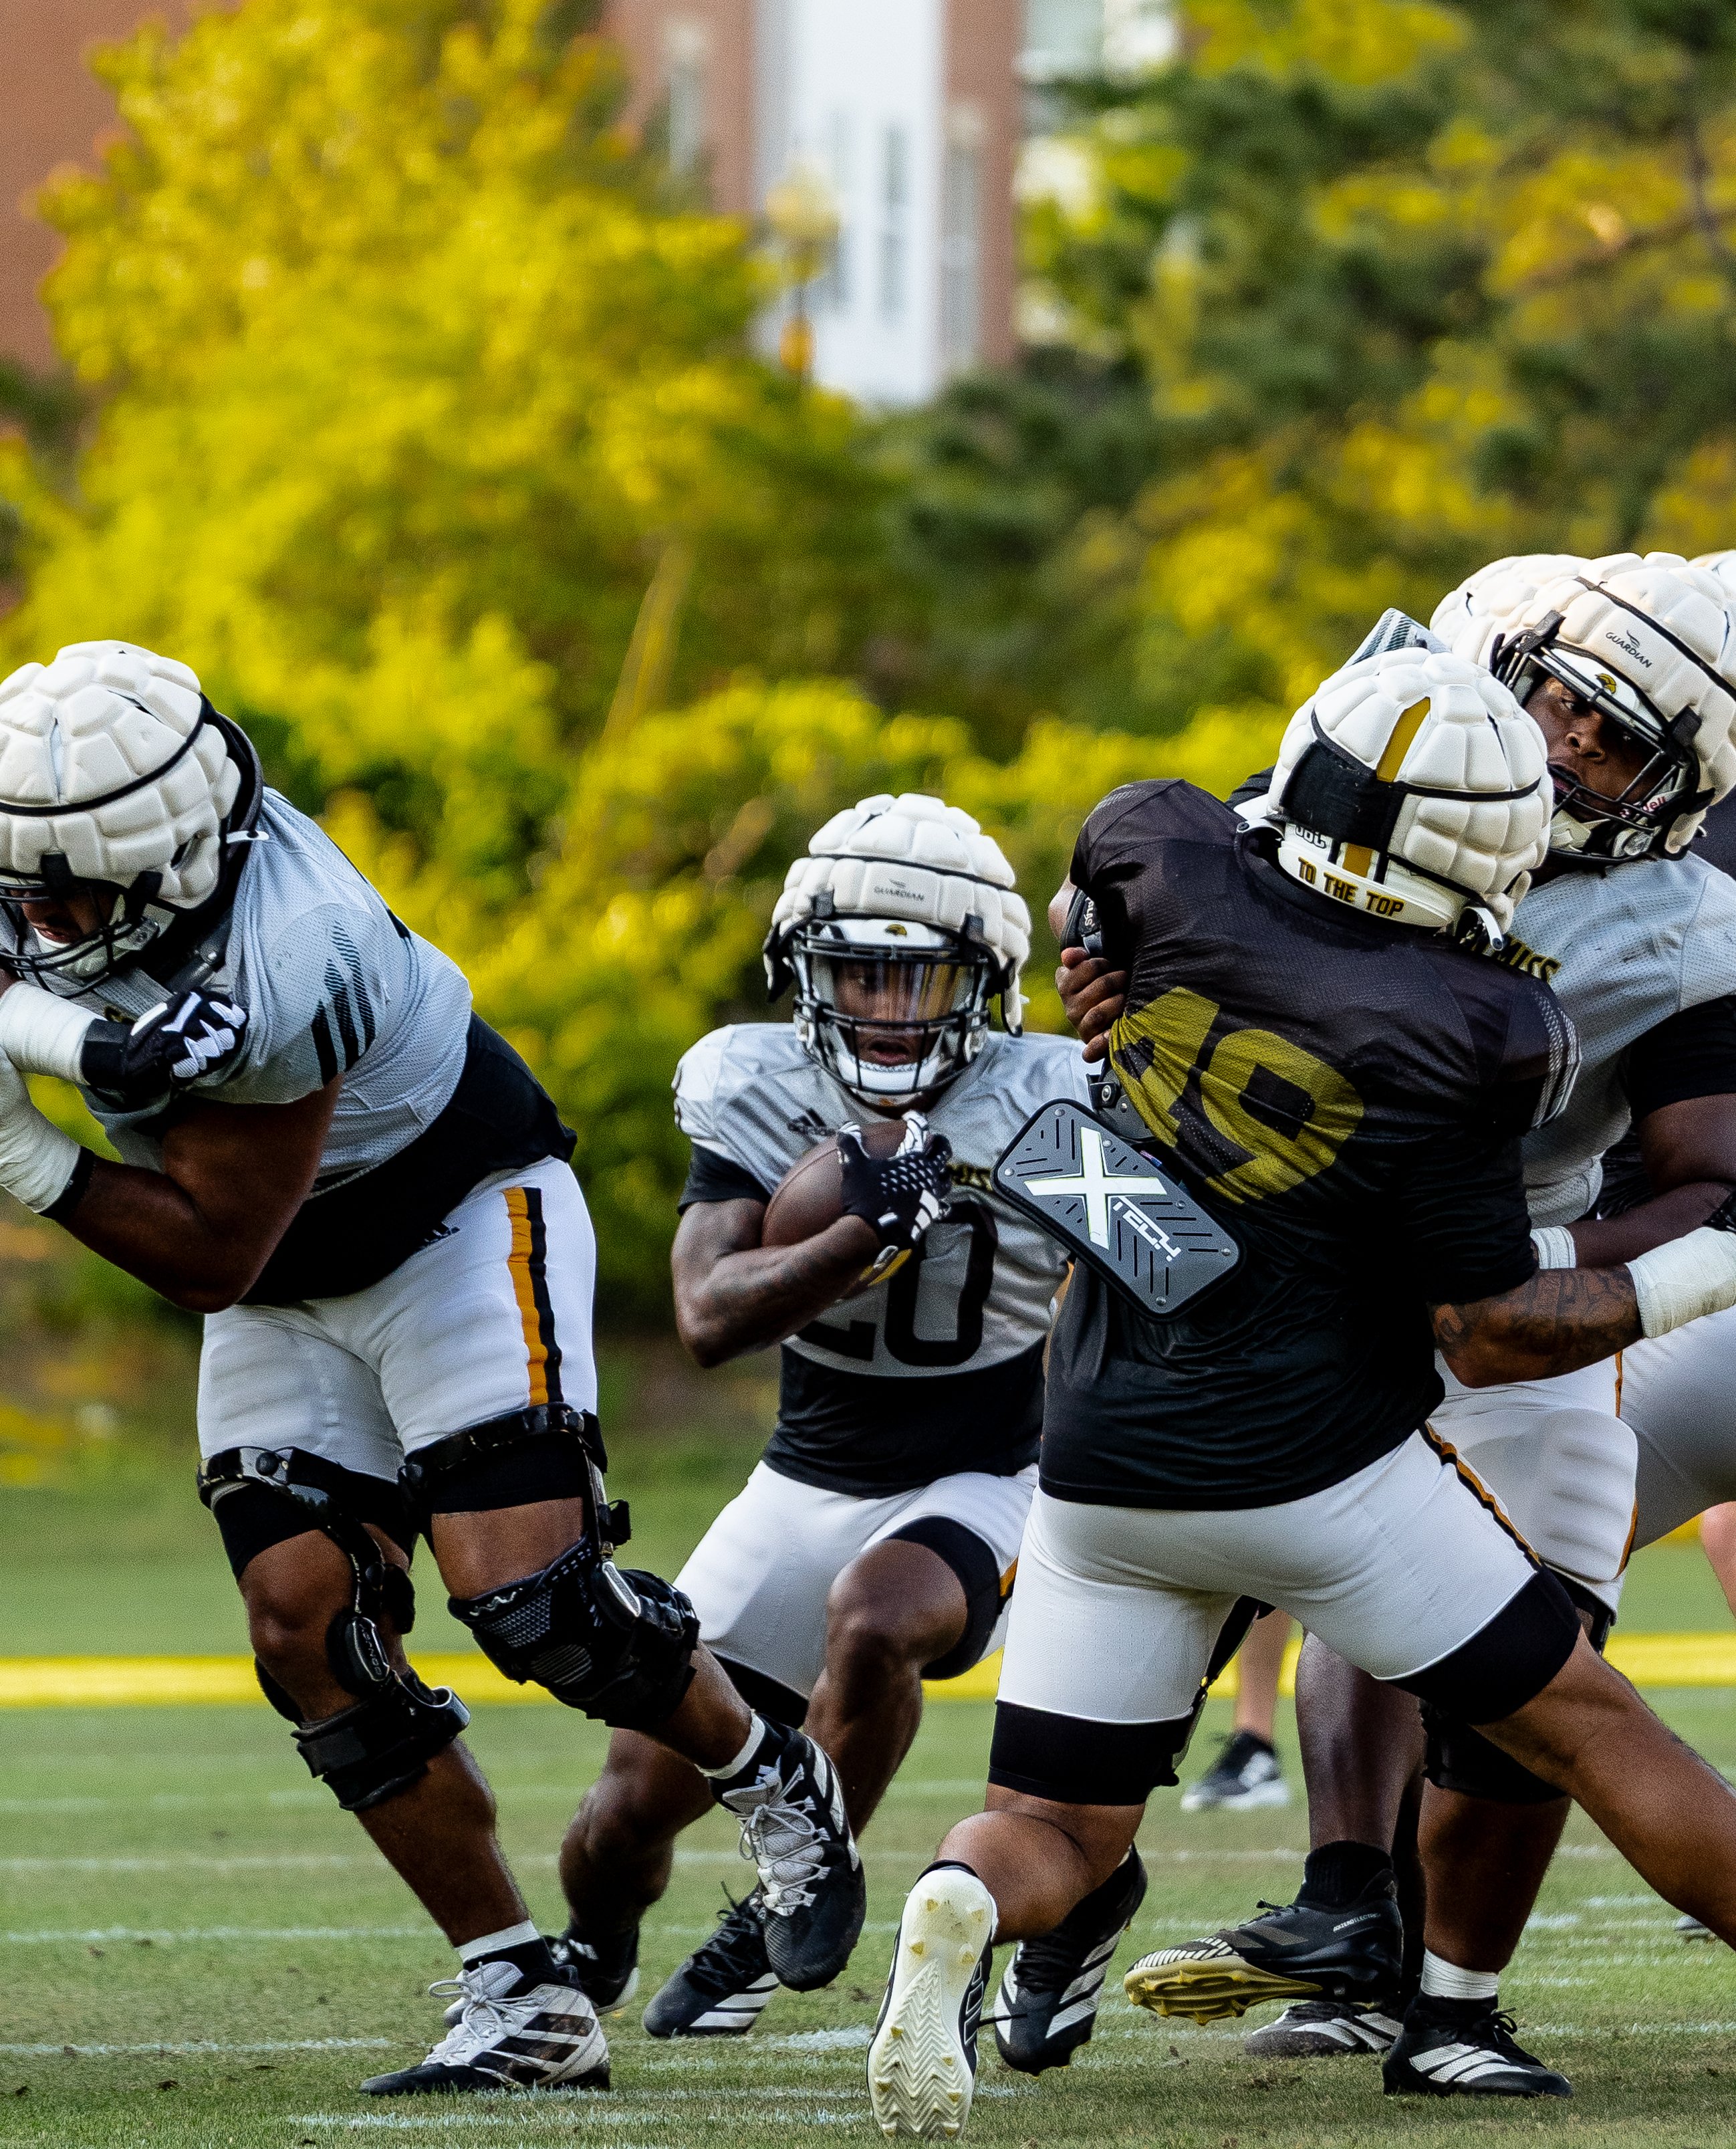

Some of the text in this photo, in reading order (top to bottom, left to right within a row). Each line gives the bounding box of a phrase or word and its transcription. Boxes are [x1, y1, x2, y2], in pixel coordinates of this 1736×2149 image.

[1605, 632, 1652, 668] GUARDIAN
[874, 885, 925, 901] GUARDIAN
[1297, 857, 1405, 917] TO THE TOP
